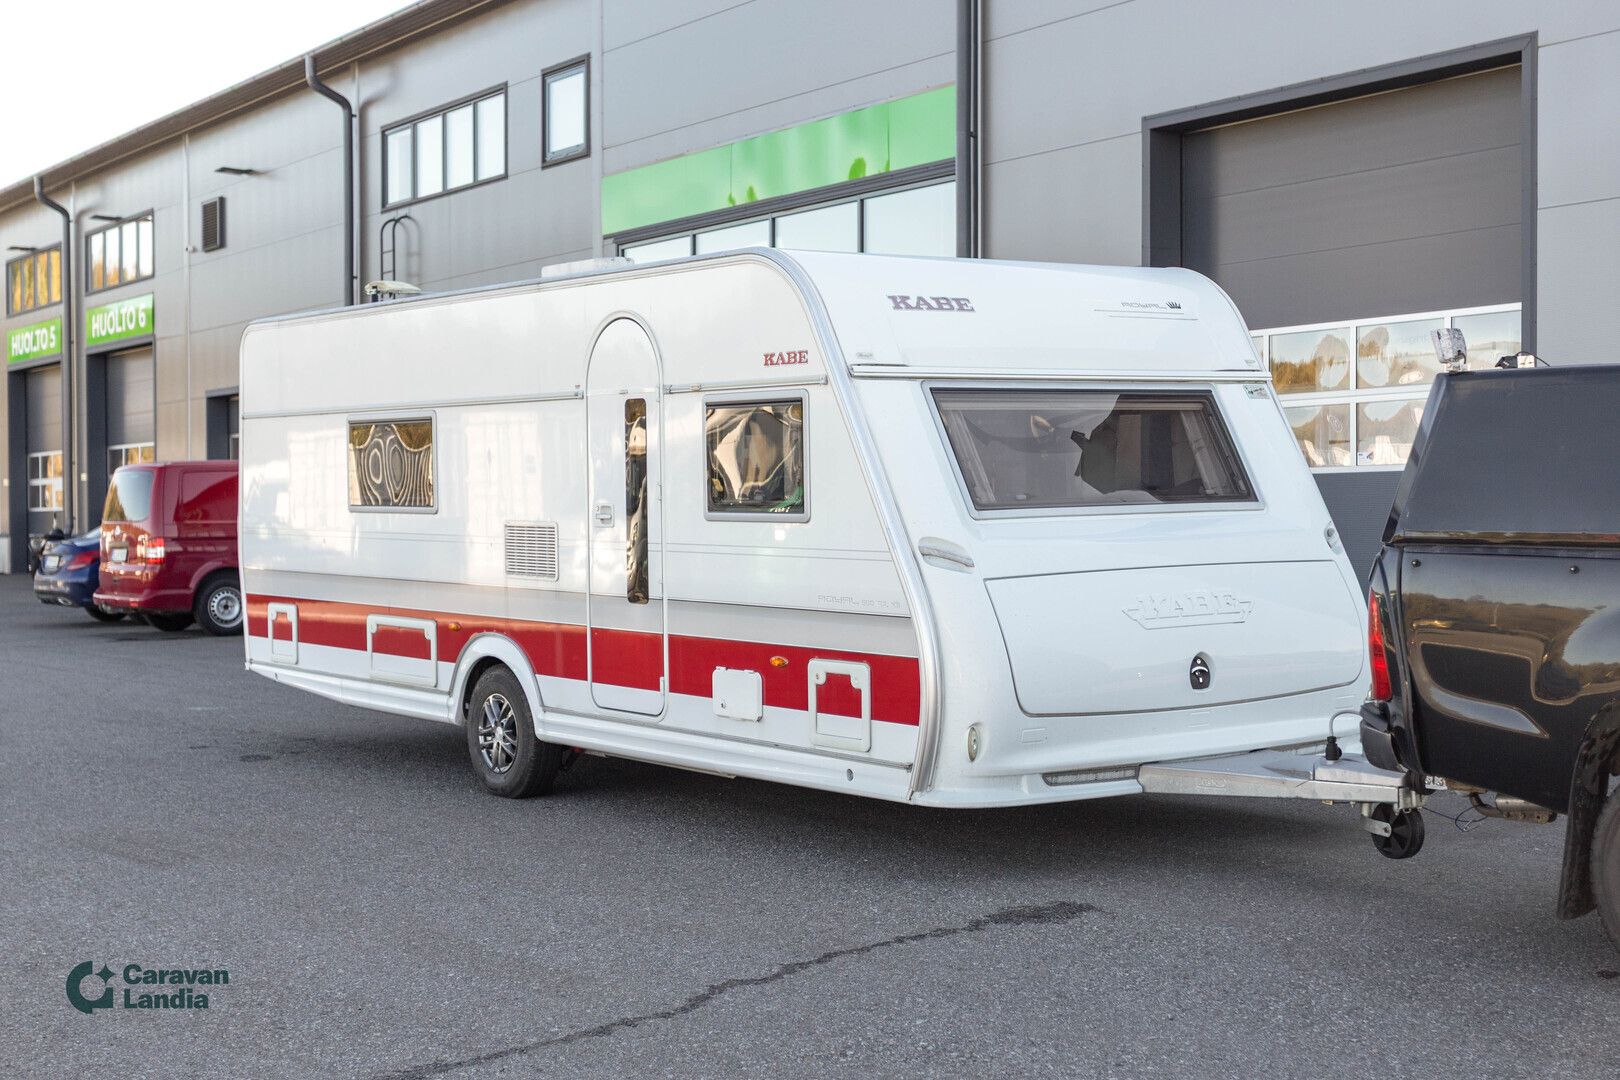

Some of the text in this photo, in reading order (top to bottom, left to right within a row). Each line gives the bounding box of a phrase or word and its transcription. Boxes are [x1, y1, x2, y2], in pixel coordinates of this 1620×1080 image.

[887, 294, 976, 312] KABE
[91, 305, 147, 339] HUOLTO 6
[11, 325, 56, 356] HUOLTO 5
[763, 350, 809, 367] KABE
